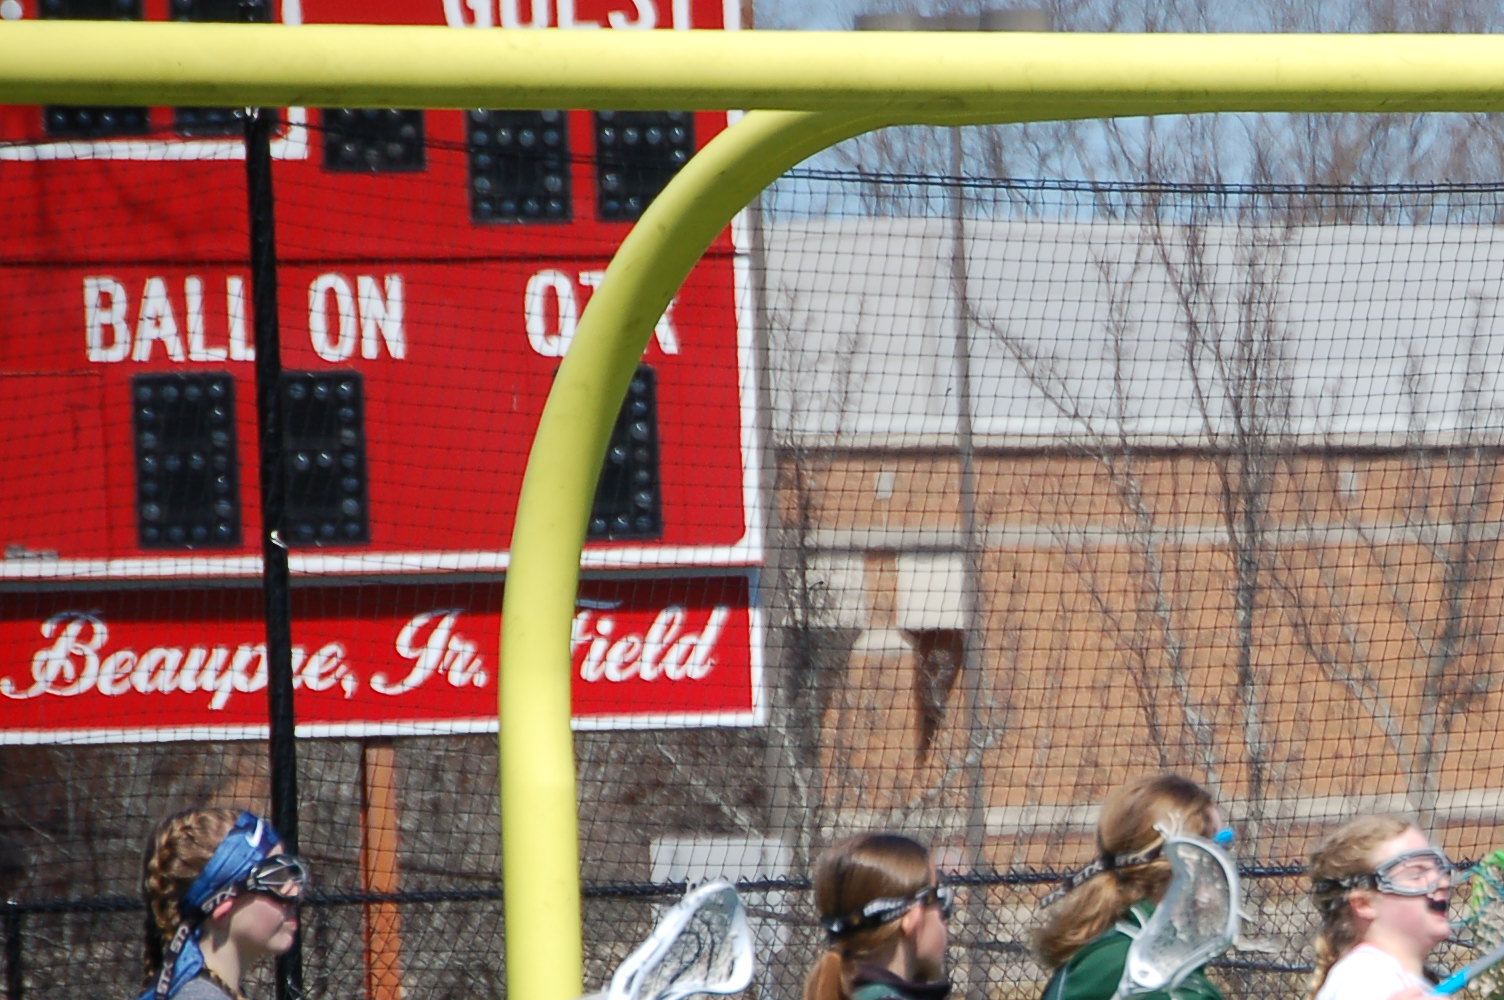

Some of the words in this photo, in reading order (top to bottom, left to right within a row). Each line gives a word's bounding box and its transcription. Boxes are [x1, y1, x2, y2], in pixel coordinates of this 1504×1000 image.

[83, 275, 255, 362] BALL
[308, 272, 405, 362] ON
[370, 607, 489, 696] Jr.
